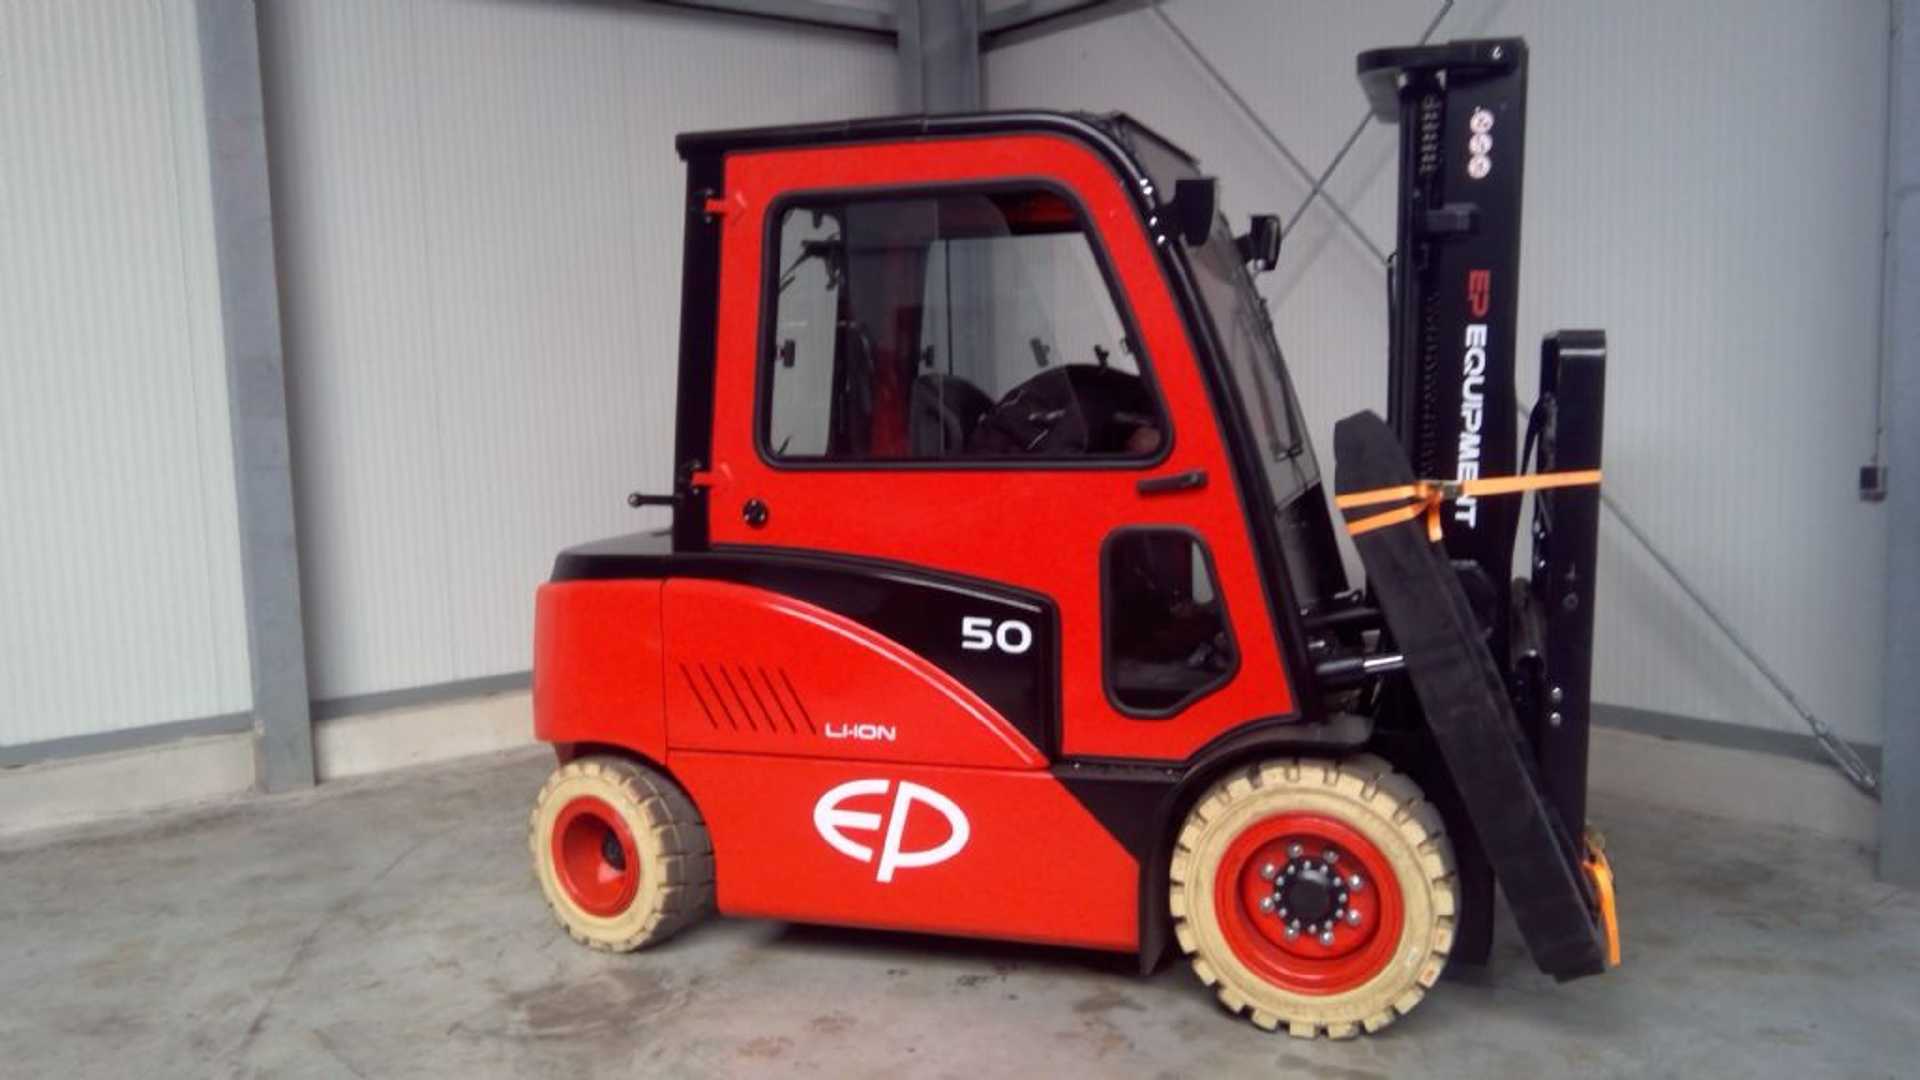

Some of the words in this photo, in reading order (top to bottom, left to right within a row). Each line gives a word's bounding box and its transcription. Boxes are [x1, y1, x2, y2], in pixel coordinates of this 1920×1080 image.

[1469, 269, 1489, 317] EP
[962, 616, 1032, 654] 50
[825, 722, 896, 741] LI-ION
[813, 779, 970, 884] EP
